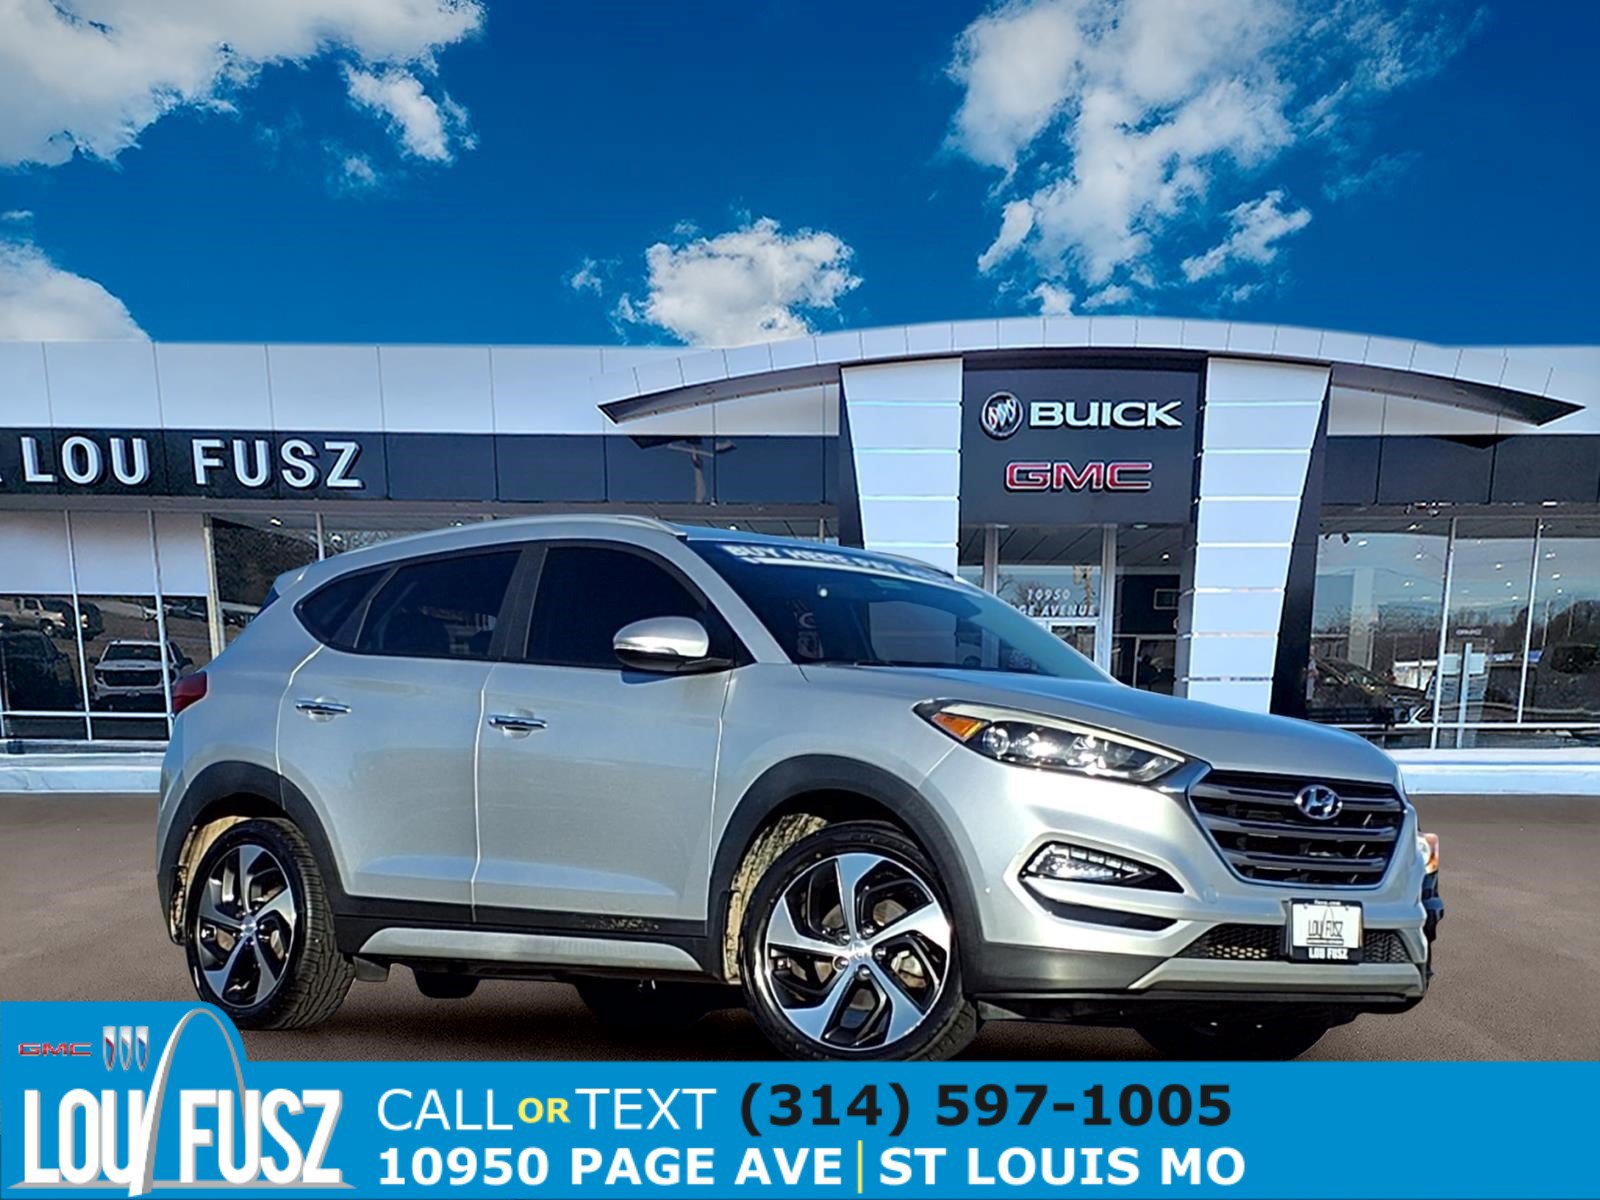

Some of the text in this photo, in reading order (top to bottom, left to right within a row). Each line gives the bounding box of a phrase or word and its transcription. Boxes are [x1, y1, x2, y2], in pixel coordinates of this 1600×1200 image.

[1030, 401, 1182, 426] BUICK
[20, 436, 363, 488] LOU FUSZ
[1006, 462, 1152, 489] GMC
[1027, 588, 1071, 601] 10950
[1041, 604, 1096, 616] AVENUE
[1308, 920, 1324, 938] LOU
[1308, 947, 1349, 960] LOU FUSZ
